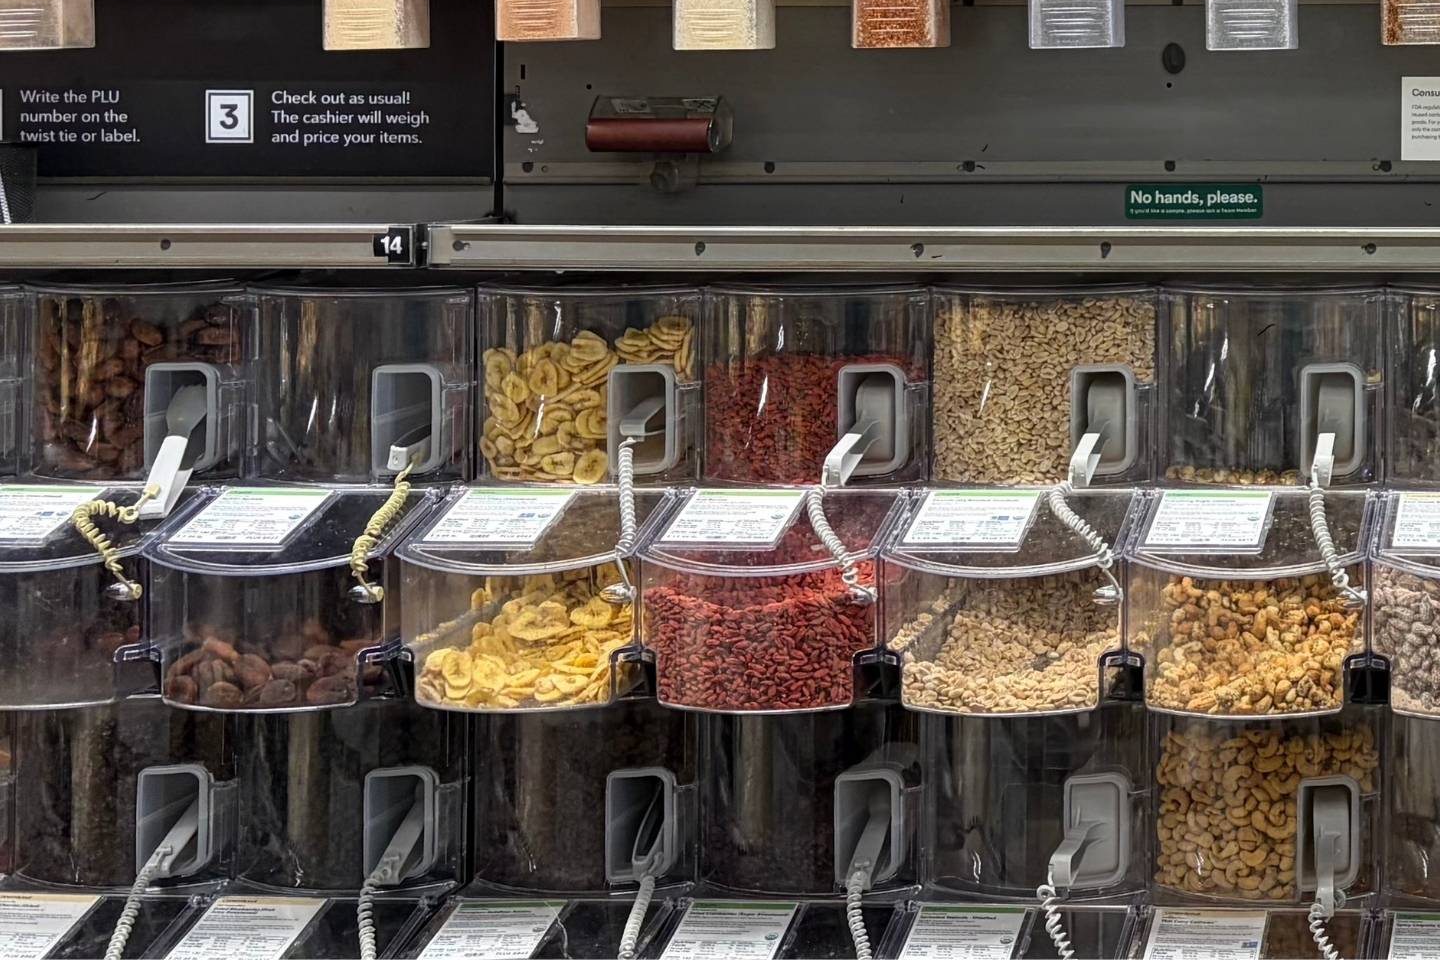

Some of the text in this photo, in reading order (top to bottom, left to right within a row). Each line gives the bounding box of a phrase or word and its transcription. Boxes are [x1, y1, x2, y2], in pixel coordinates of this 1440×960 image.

[20, 89, 120, 104] Write the PLU
[271, 90, 411, 105] Check out as usual!
[20, 109, 128, 124] number on the
[219, 103, 239, 130] 3
[270, 110, 430, 127] The cashier will weigh
[20, 128, 141, 143] twist tie or label.
[271, 129, 423, 148] and price your items.
[1130, 189, 1259, 207] No hands, please.
[380, 235, 403, 254] 14
